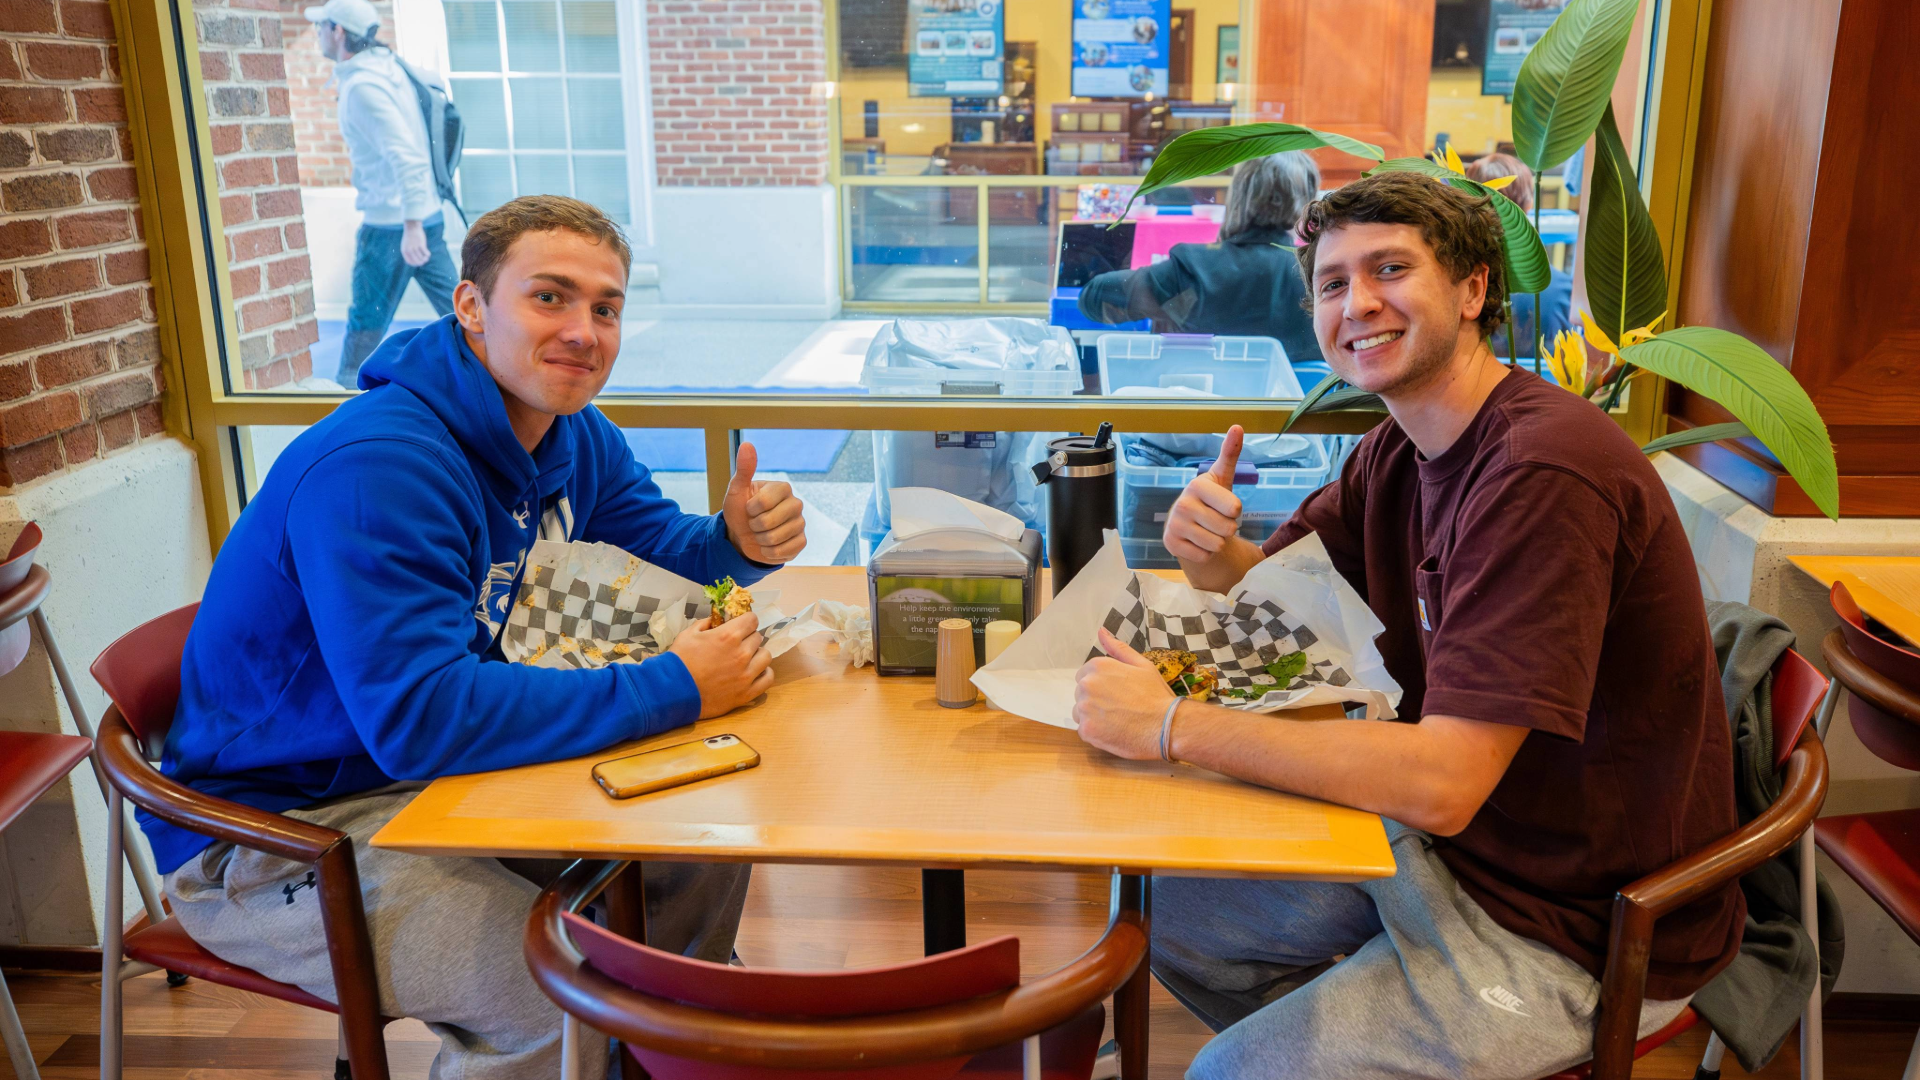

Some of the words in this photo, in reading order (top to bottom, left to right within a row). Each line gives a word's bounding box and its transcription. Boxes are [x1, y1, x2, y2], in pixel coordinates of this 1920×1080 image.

[900, 604, 917, 613] Help
[920, 605, 937, 613] keep
[953, 605, 1001, 613] environment
[911, 625, 923, 633] the
[1488, 985, 1524, 1011] NIKE
